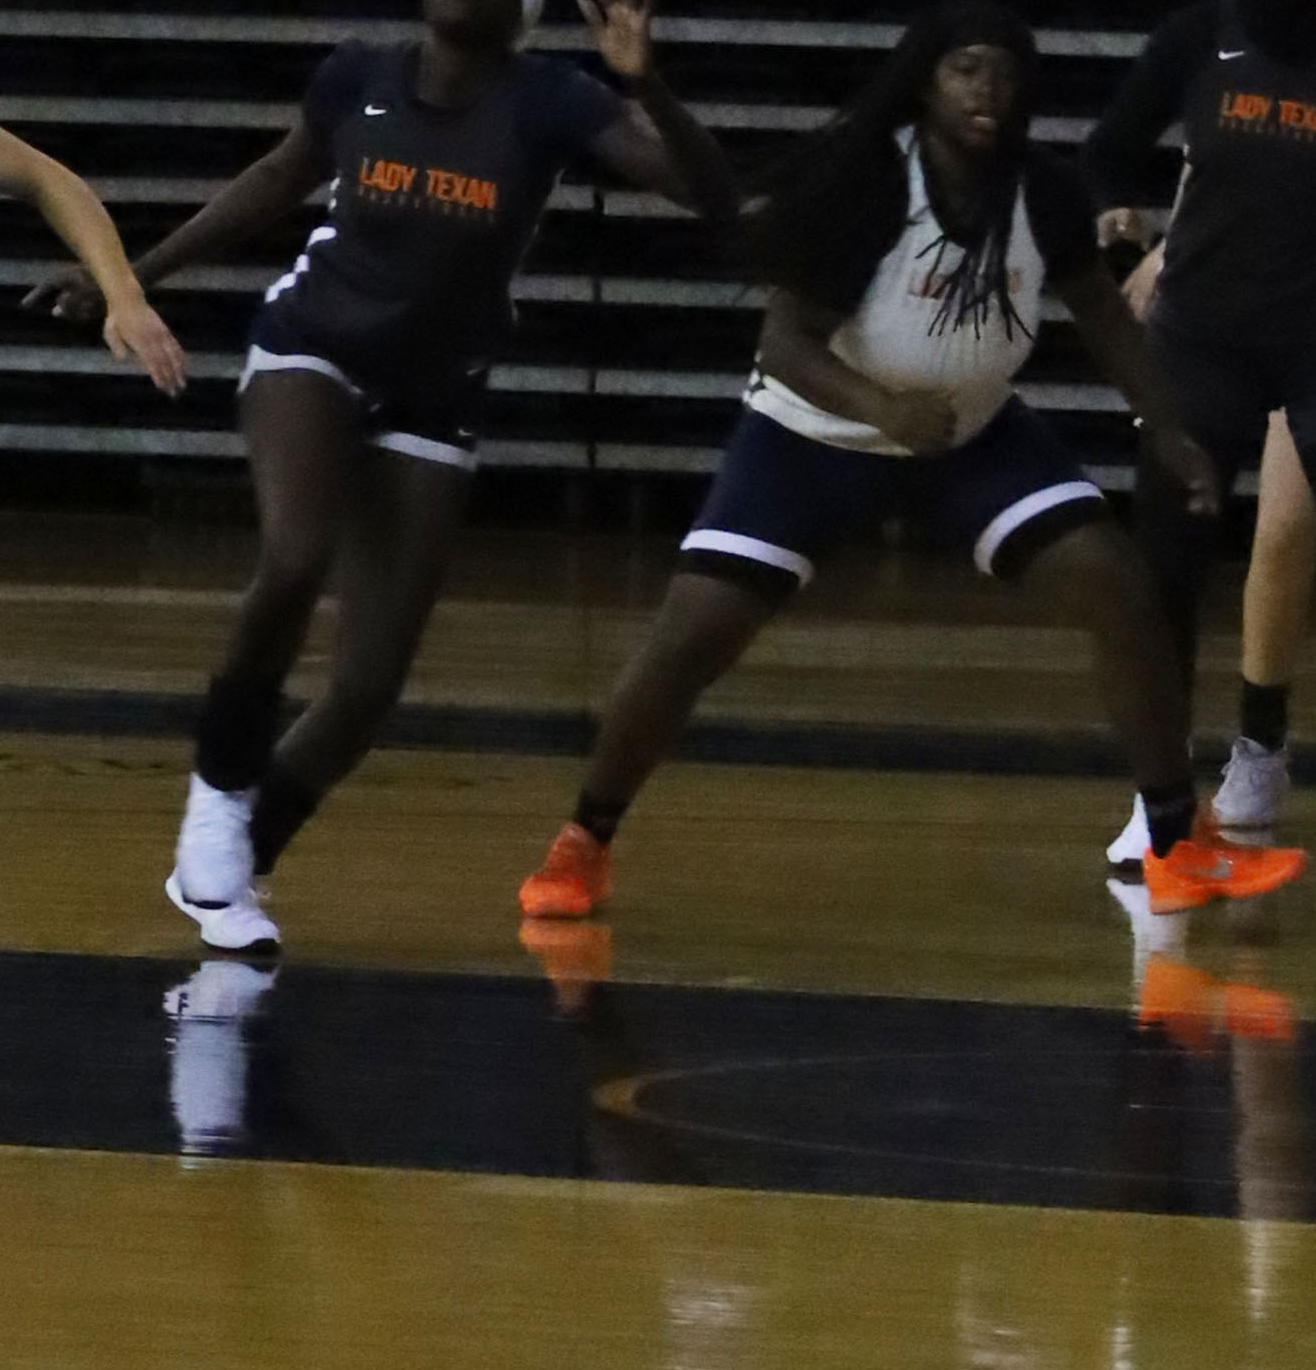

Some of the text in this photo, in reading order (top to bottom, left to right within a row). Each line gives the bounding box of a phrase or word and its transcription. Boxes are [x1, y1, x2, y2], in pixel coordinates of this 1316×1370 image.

[1220, 91, 1271, 121] LADY
[359, 157, 417, 193] LADY
[426, 167, 498, 210] TEXAN
